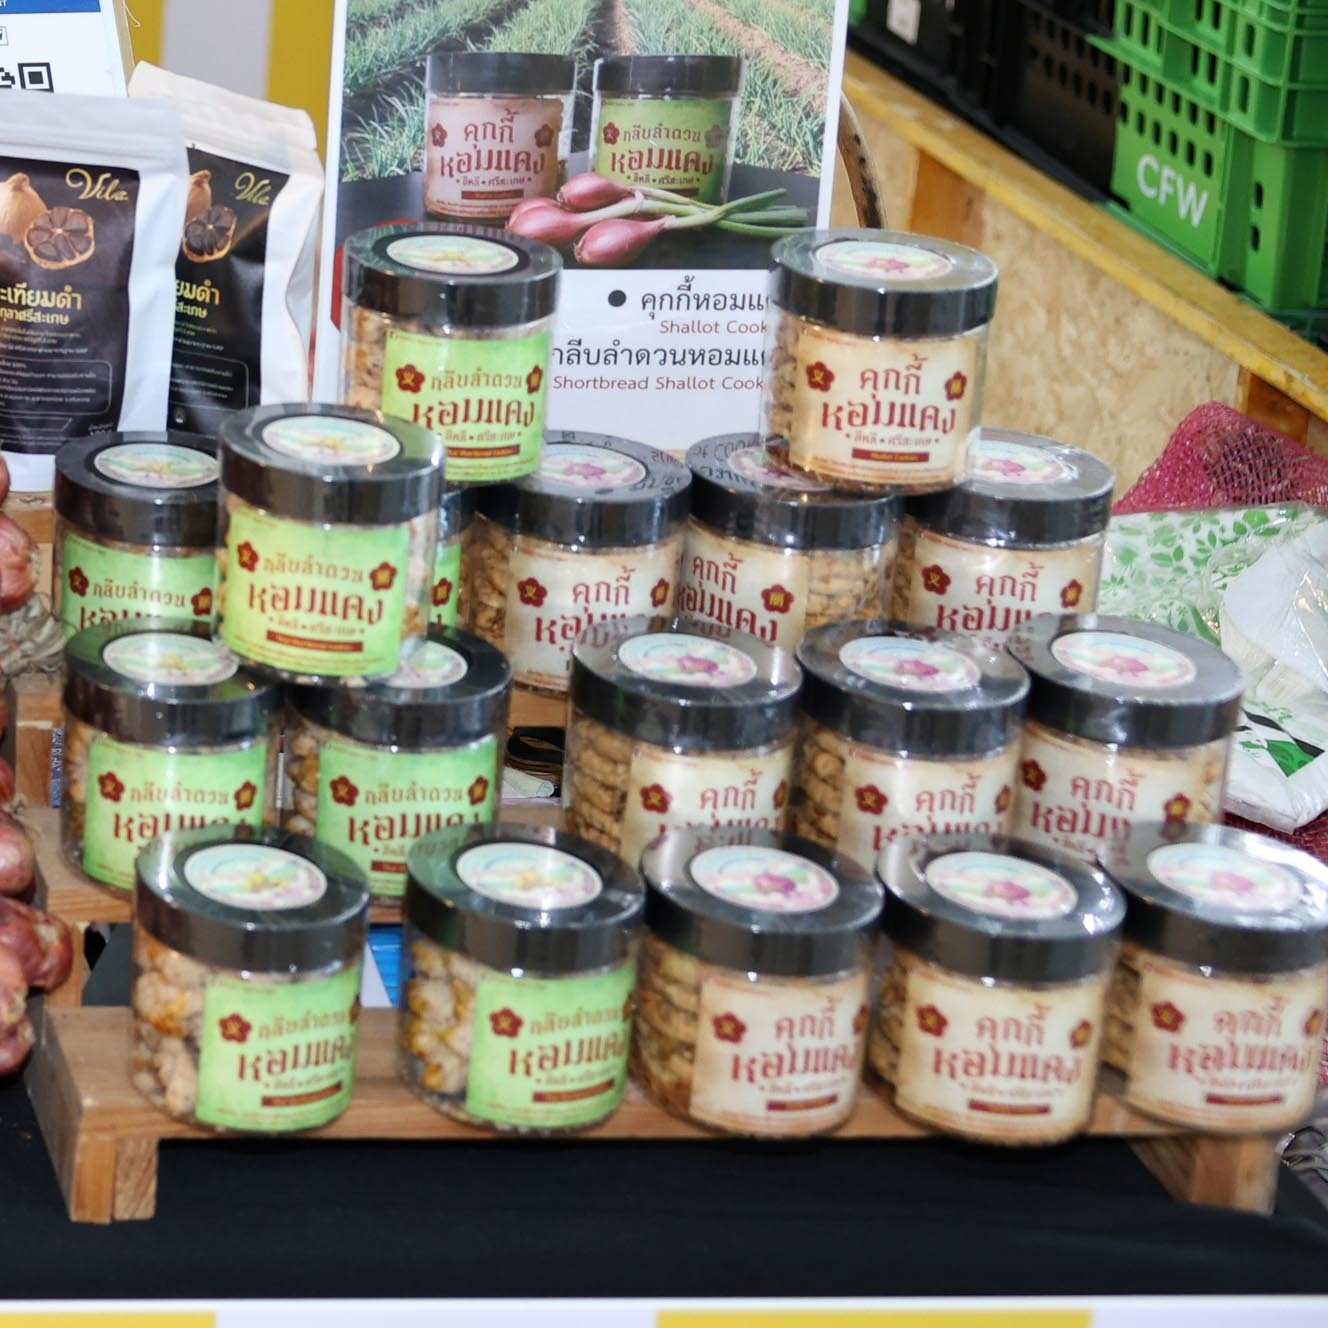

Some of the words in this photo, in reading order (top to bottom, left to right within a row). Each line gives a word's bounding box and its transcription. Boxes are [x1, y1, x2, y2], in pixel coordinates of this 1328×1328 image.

[464, 108, 520, 149] คุกกี้
[622, 122, 702, 145] กลีบลำดวน
[440, 147, 545, 178] หอมแดง
[610, 146, 714, 177] หอมแดง
[1135, 154, 1209, 228] CFW
[641, 274, 769, 320] คุกกี้หอมแ
[659, 320, 721, 335] Shallot
[429, 365, 523, 392] กลีบลำดวน
[553, 375, 649, 391] Shortbread
[655, 375, 715, 391] Shallot
[859, 353, 929, 399] คุกกี้
[411, 397, 536, 430] หอมแดง
[821, 399, 958, 435] หอมแดง
[573, 566, 635, 612] คุกกี้
[975, 562, 1044, 604] คุกกี้
[247, 583, 385, 627] หอมแดง
